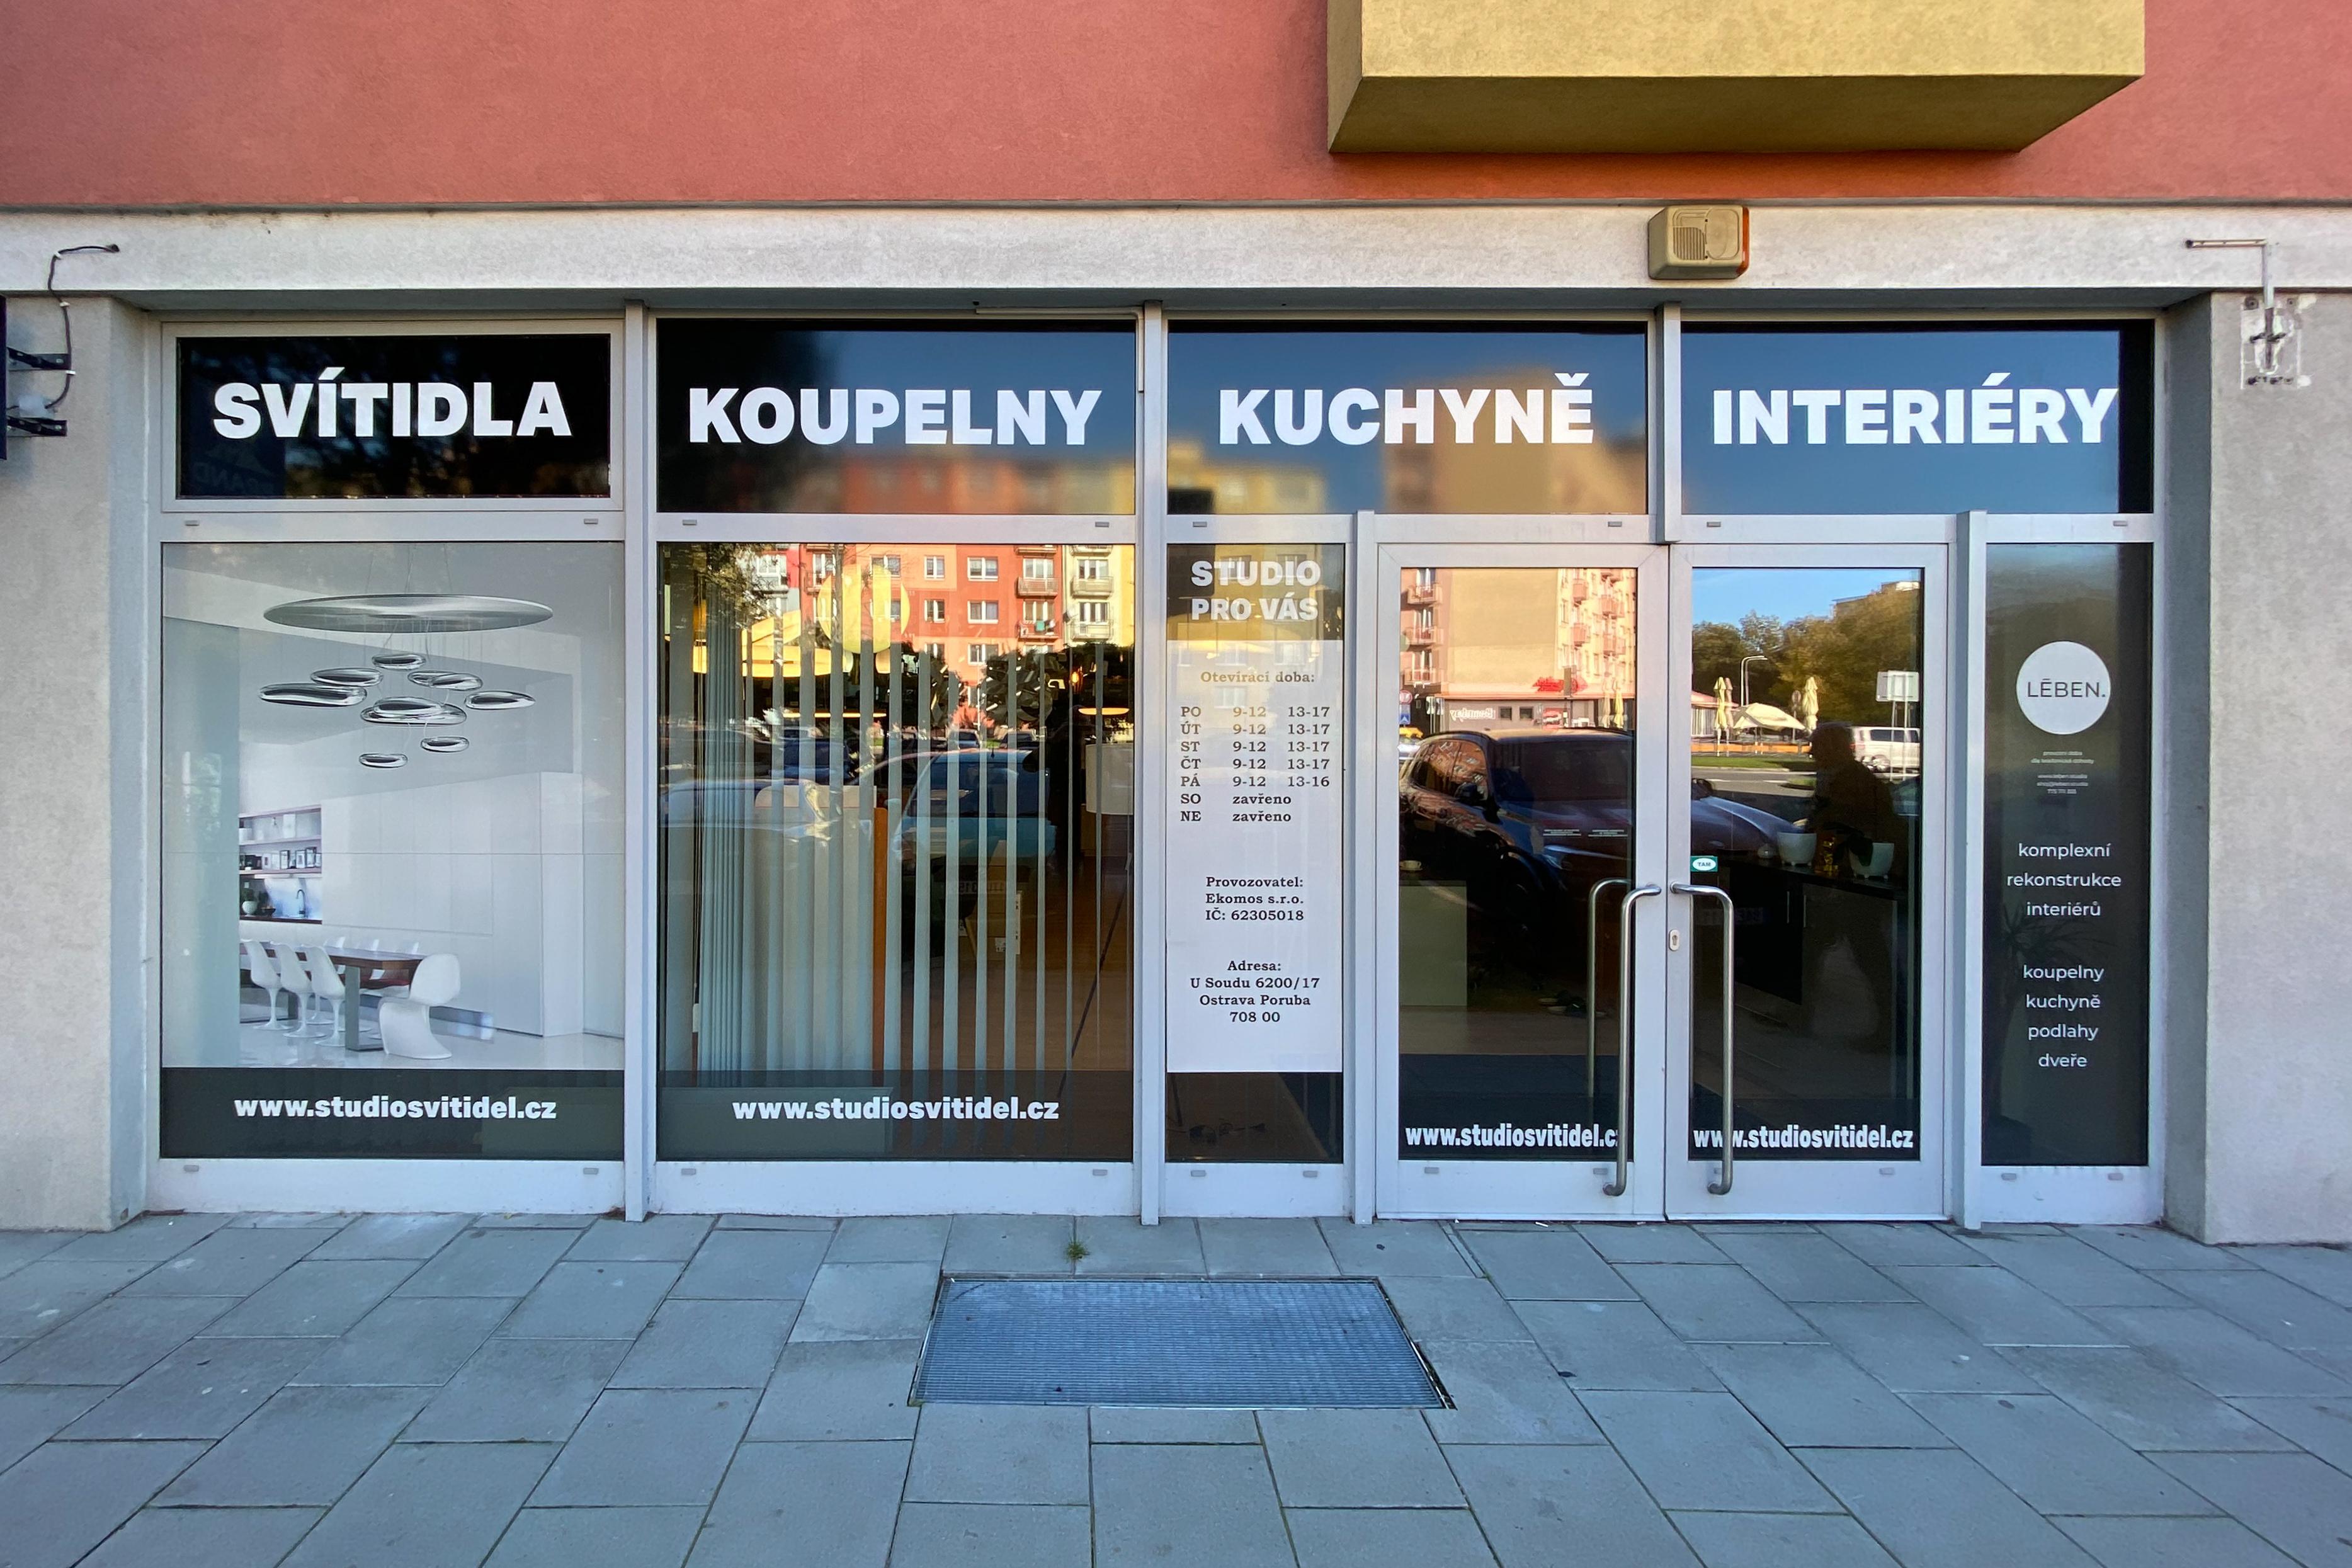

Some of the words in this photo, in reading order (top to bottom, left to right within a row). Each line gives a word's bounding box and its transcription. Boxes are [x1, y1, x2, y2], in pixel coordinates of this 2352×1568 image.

[213, 367, 572, 439] SVÍTIDLA
[1220, 373, 1594, 445] KUCHYNĚ
[1713, 372, 2119, 444] INTERIÉRY
[690, 387, 1102, 445] KOUPELNY
[1191, 560, 1321, 586] STUDIO
[1191, 598, 1252, 620] PRO
[1258, 592, 1318, 620] VÁS
[1201, 671, 1270, 683] Otevírací
[1275, 671, 1315, 683] doba:
[1181, 707, 1201, 717] PO
[1232, 707, 1266, 717] 9-12
[1288, 707, 1330, 717] 13-17
[1181, 721, 1201, 735] ÚT
[1232, 725, 1266, 735] 9-12
[1288, 725, 1330, 735] 13-17
[1181, 742, 1201, 752] ST
[1232, 742, 1266, 752] 9-12
[1288, 742, 1330, 752] 13-17
[1181, 756, 1201, 770] ČT
[1232, 759, 1266, 770] 9-12
[1288, 759, 1330, 770] 13-17
[1181, 773, 1201, 787] PÁ
[1232, 776, 1266, 787] 9-12
[1288, 776, 1330, 787] 13-16
[1181, 794, 1201, 804] SO
[1232, 793, 1291, 804] zavřeno
[1181, 811, 1201, 821] NE
[1232, 810, 1291, 822] zavřeno
[2018, 843, 2110, 860] komplexní
[1205, 877, 1304, 887] Provozovatel:
[2007, 873, 2122, 887] rekonstrukce
[1205, 894, 1263, 904] Ekomos
[1268, 894, 1304, 904] s.r.o.
[1205, 907, 1226, 921] IČ:
[1231, 911, 1304, 921] 62305018
[2026, 901, 2101, 916] interiérů
[1227, 960, 1281, 971] Adresa:
[2023, 965, 2104, 982] koupelny
[1190, 978, 1200, 988] U
[1205, 977, 1250, 988] Soudu
[1255, 977, 1319, 990] 6200/17
[1200, 995, 1255, 1006] Ostrava
[1260, 995, 1310, 1006] Poruba
[2026, 994, 2101, 1011] kuchyně
[1230, 1012, 1256, 1023] 708
[1261, 1012, 1280, 1023] 00
[2028, 1024, 2098, 1041] podlahy
[2038, 1054, 2088, 1067] dveře
[234, 1096, 557, 1119] www.studiosvitidel.cz
[732, 1096, 1059, 1119] www.studiosvitidel.cz
[1405, 1123, 1619, 1147] www.studiosvitidel.c
